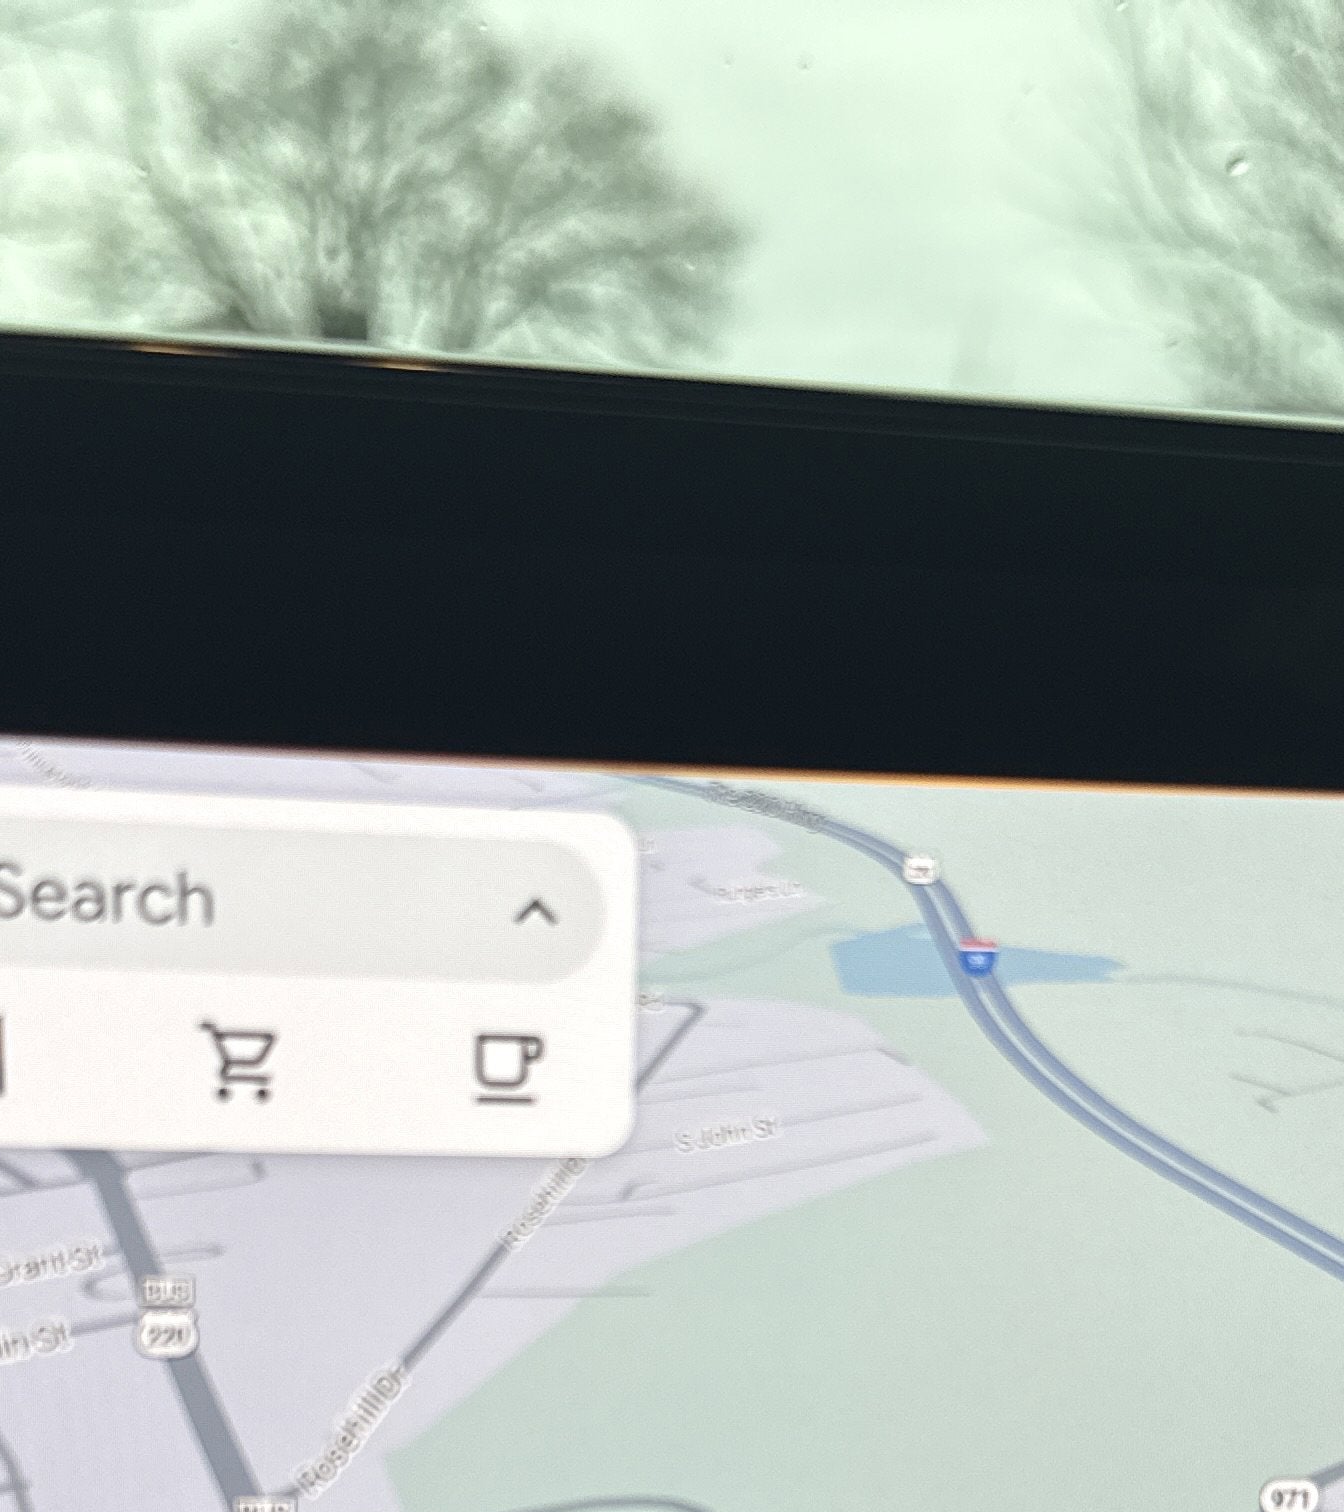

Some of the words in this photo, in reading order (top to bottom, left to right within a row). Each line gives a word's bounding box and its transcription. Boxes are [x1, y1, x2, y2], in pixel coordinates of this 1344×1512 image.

[66, 1242, 103, 1273] St
[147, 1279, 190, 1300] BUS
[35, 1322, 69, 1355] St
[299, 1385, 384, 1494] Rosehill
[1269, 1486, 1310, 1511] 971
